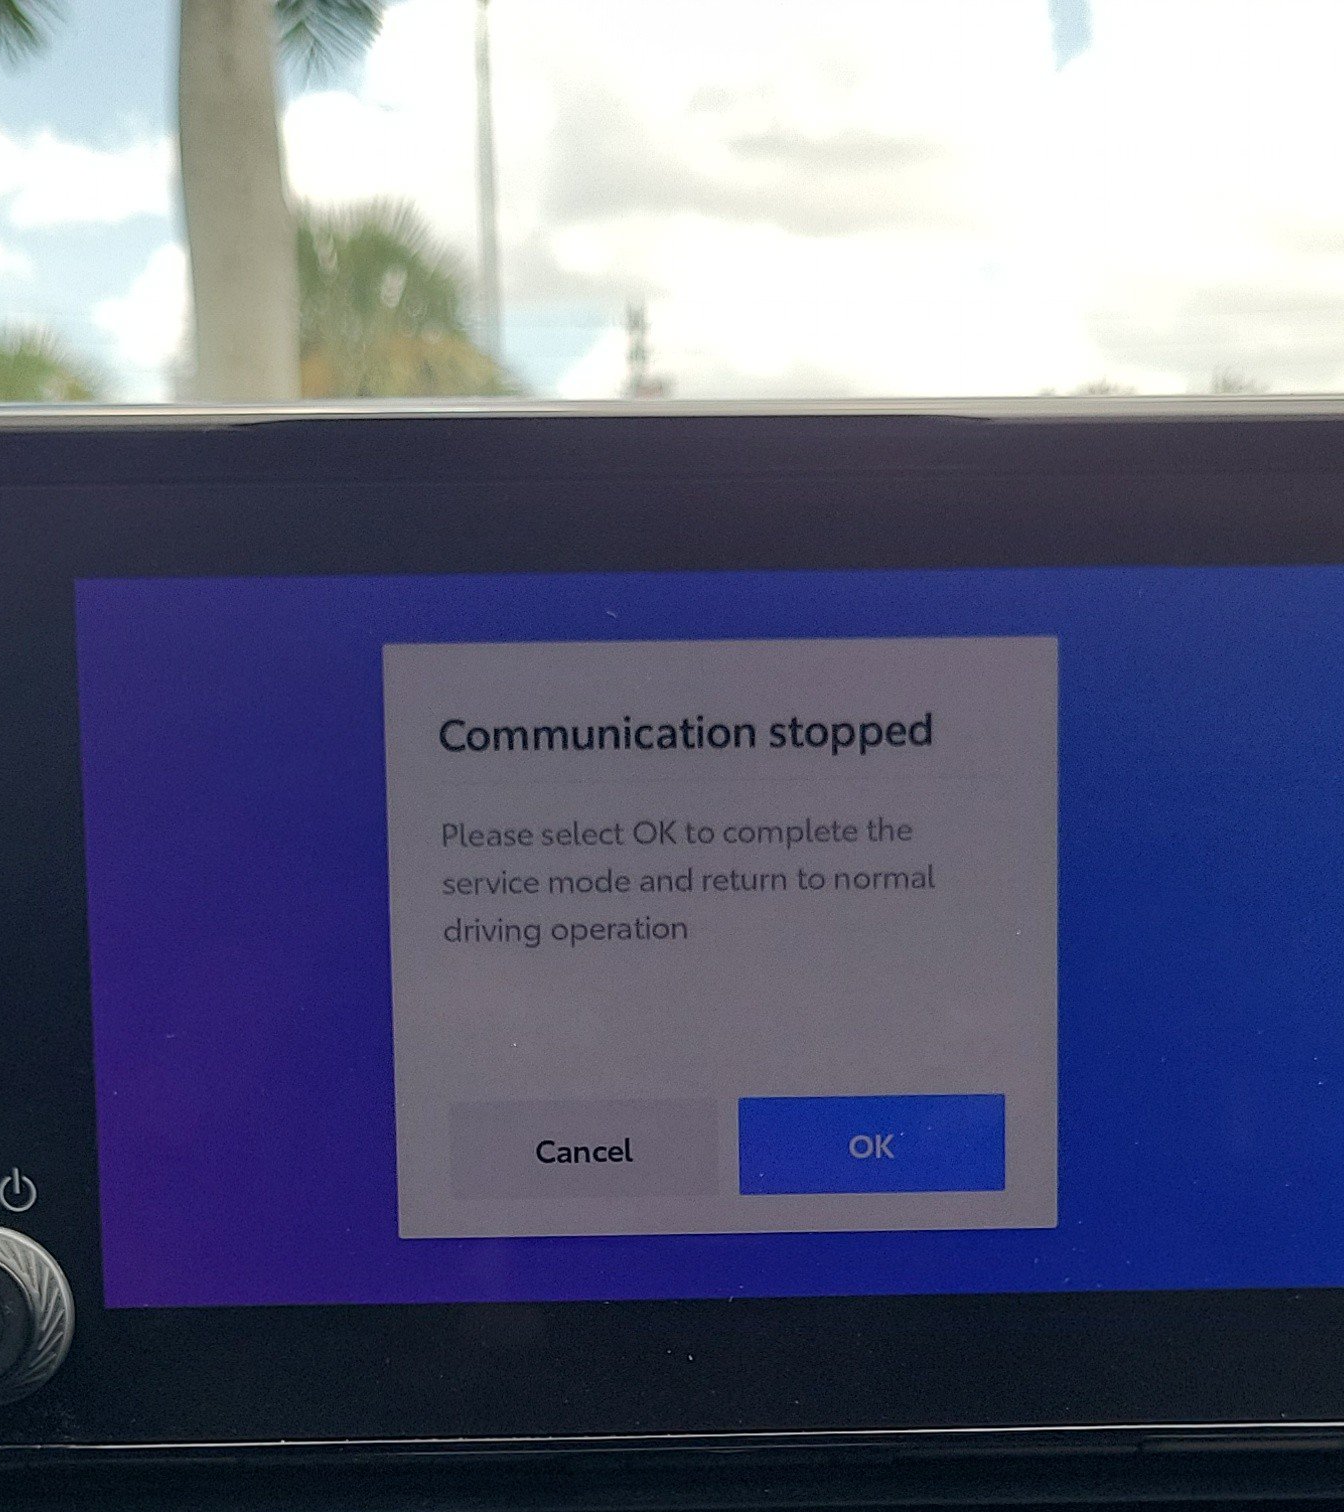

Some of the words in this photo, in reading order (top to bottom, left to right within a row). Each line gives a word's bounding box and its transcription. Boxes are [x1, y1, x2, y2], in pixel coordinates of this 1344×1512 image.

[438, 714, 757, 753] Communication
[769, 711, 933, 756] stopped
[441, 822, 534, 848] Please
[541, 820, 624, 847] select
[632, 819, 677, 846] OK
[684, 822, 716, 845] to
[722, 817, 859, 850] complete
[866, 815, 914, 843] the
[442, 869, 540, 896] service
[548, 867, 631, 894] mode
[639, 866, 694, 893] and
[701, 869, 788, 892] return
[796, 867, 827, 891] to
[833, 863, 936, 891] normal
[442, 917, 542, 949] driving
[550, 915, 689, 948] operation
[535, 1137, 634, 1164] Cancel
[848, 1133, 895, 1159] OK
